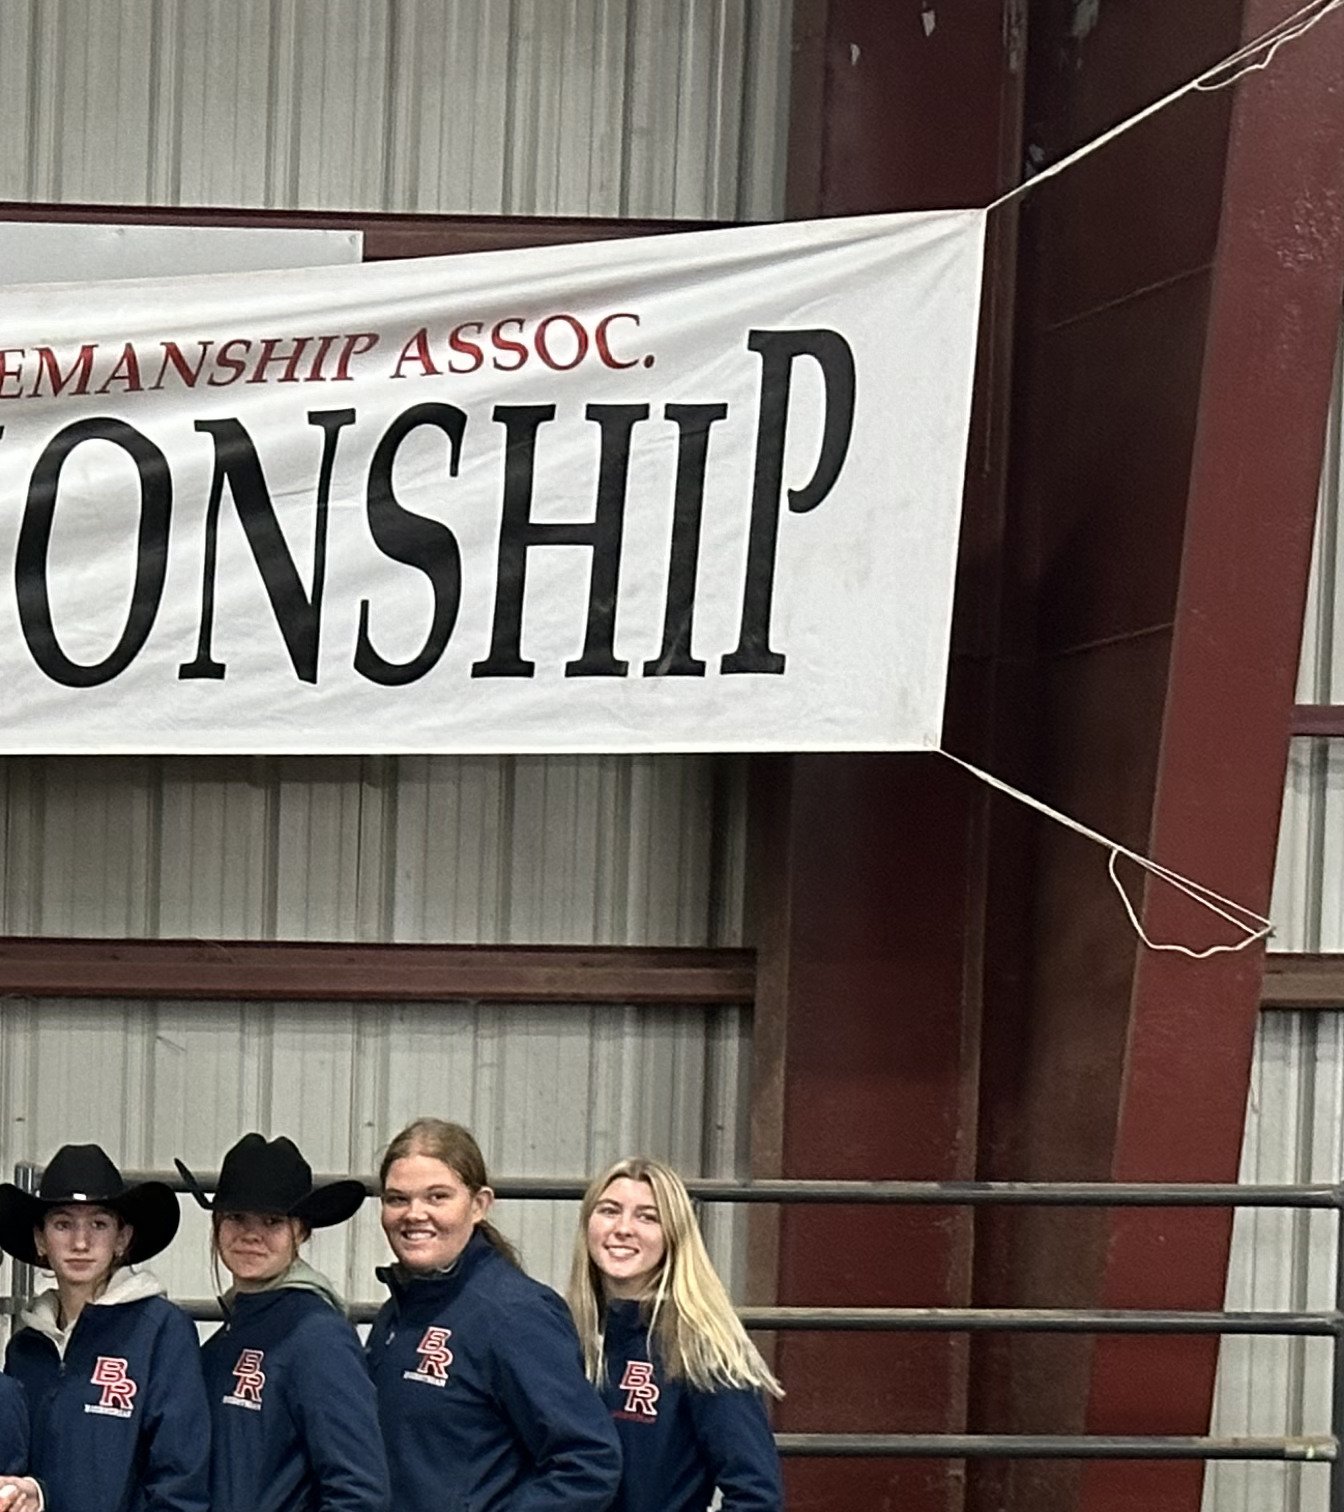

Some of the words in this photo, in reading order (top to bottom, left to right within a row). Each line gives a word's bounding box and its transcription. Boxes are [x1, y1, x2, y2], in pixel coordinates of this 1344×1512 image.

[389, 312, 656, 380] ASSOC.
[232, 1348, 266, 1402] BR
[416, 1326, 453, 1379] BR
[90, 1356, 137, 1410] BR
[619, 1360, 660, 1415] BR
